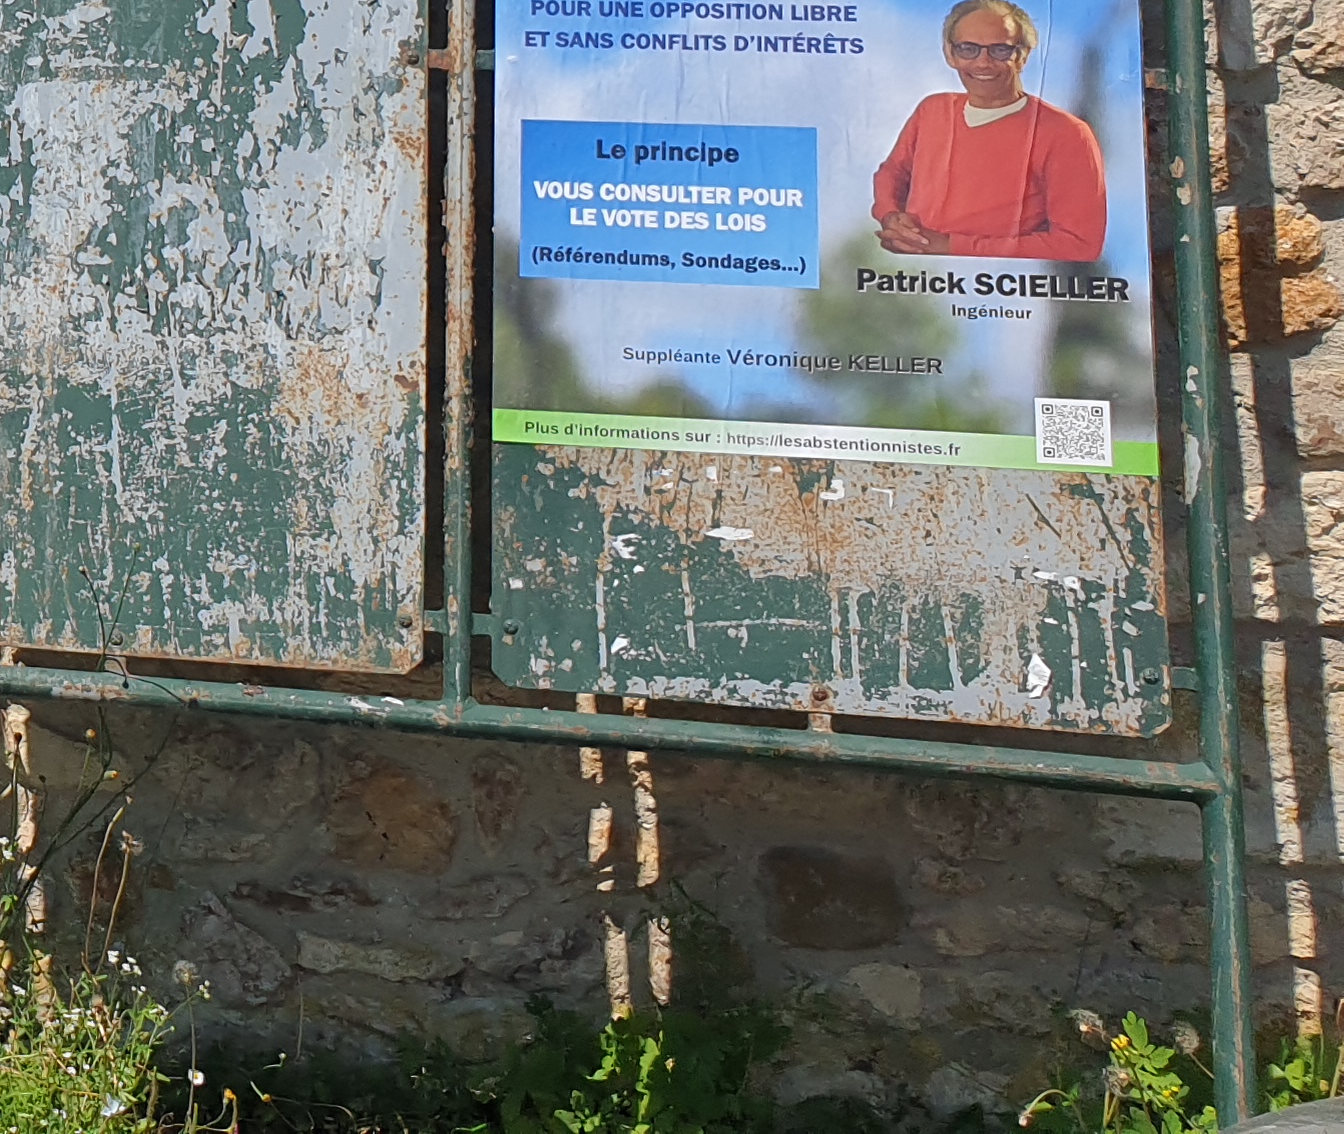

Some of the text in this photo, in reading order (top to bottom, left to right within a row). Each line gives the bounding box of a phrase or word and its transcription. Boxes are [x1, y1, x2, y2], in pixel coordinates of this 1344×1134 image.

[530, 0, 857, 22] POUR UNE OPPOSITION LIBRE
[524, 31, 864, 54] ET SANS CONFLITS D'INTÉRÊTS
[596, 139, 740, 166] Le principe
[533, 180, 803, 207] VOUS CONSULTER POUR
[570, 208, 766, 232] LE VOTE DES LOIS
[532, 246, 806, 274] (Référendums, Sondages...)
[857, 268, 1130, 301] Patrick SCIELLER
[952, 304, 1032, 319] Ingénieur
[622, 346, 944, 375] Suppléante Véronique KELLER
[524, 420, 962, 457] Plus d'informations sur https://lesabstentionnistes.fr
